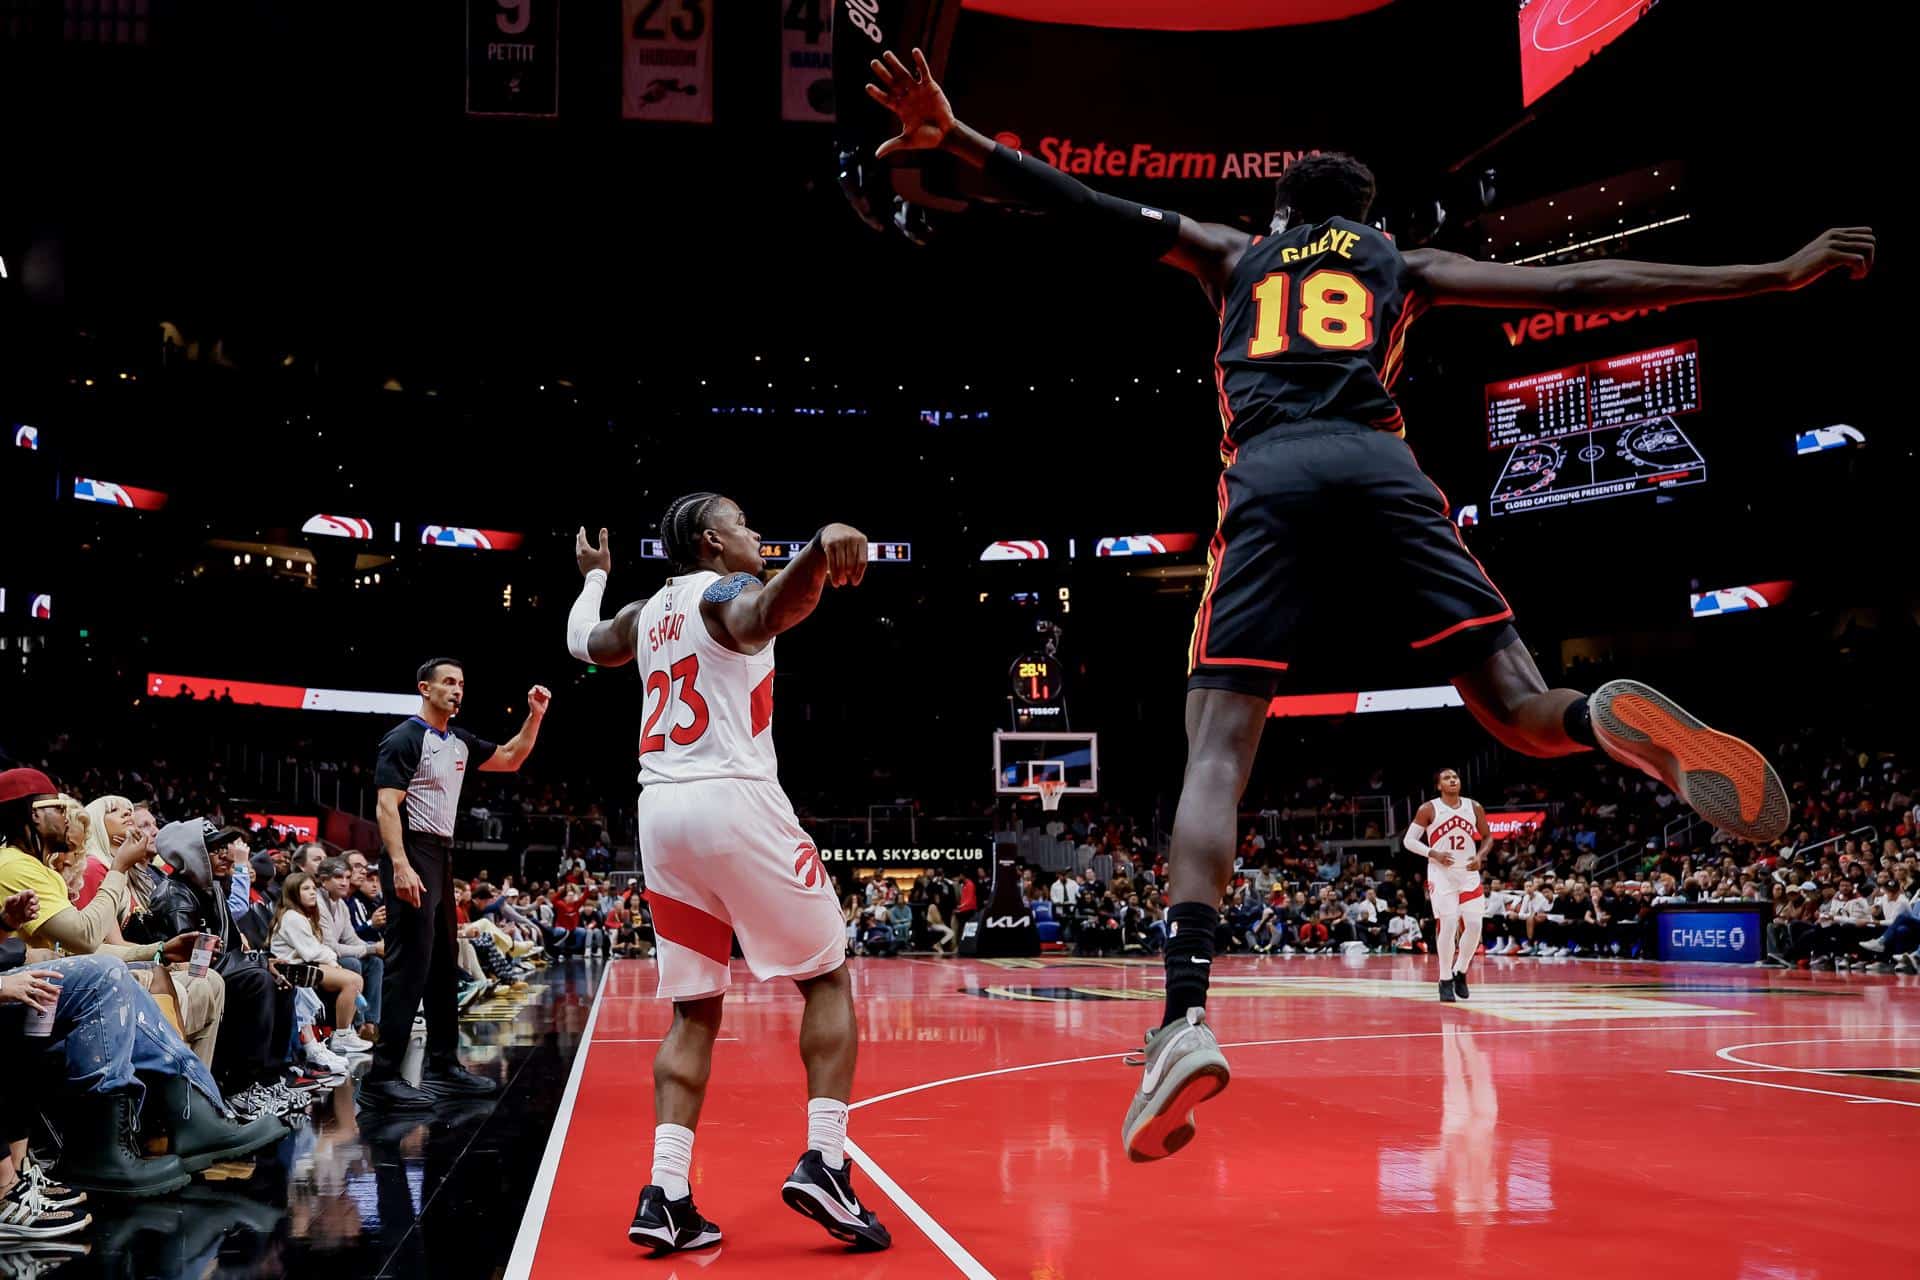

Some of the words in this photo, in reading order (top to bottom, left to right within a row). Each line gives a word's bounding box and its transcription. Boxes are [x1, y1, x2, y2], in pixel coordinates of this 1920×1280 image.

[632, 0, 705, 41] 23
[488, 41, 536, 62] PETTIT
[1221, 149, 1320, 179] AREN
[1281, 227, 1361, 264] GUEYE
[1248, 269, 1375, 358] 18
[1502, 304, 1668, 346] veriz
[1505, 499, 1532, 510] CLOSED
[1534, 491, 1580, 505] CAPTIONING
[1582, 485, 1623, 498] PRESENTED
[1625, 482, 1636, 490] BY
[1019, 663, 1047, 677] 28.4
[639, 653, 710, 756] 23
[1029, 707, 1060, 715] TISSOT
[821, 849, 877, 861] DELTA
[1449, 835, 1465, 850] 12
[1672, 929, 1727, 948] CHASE
